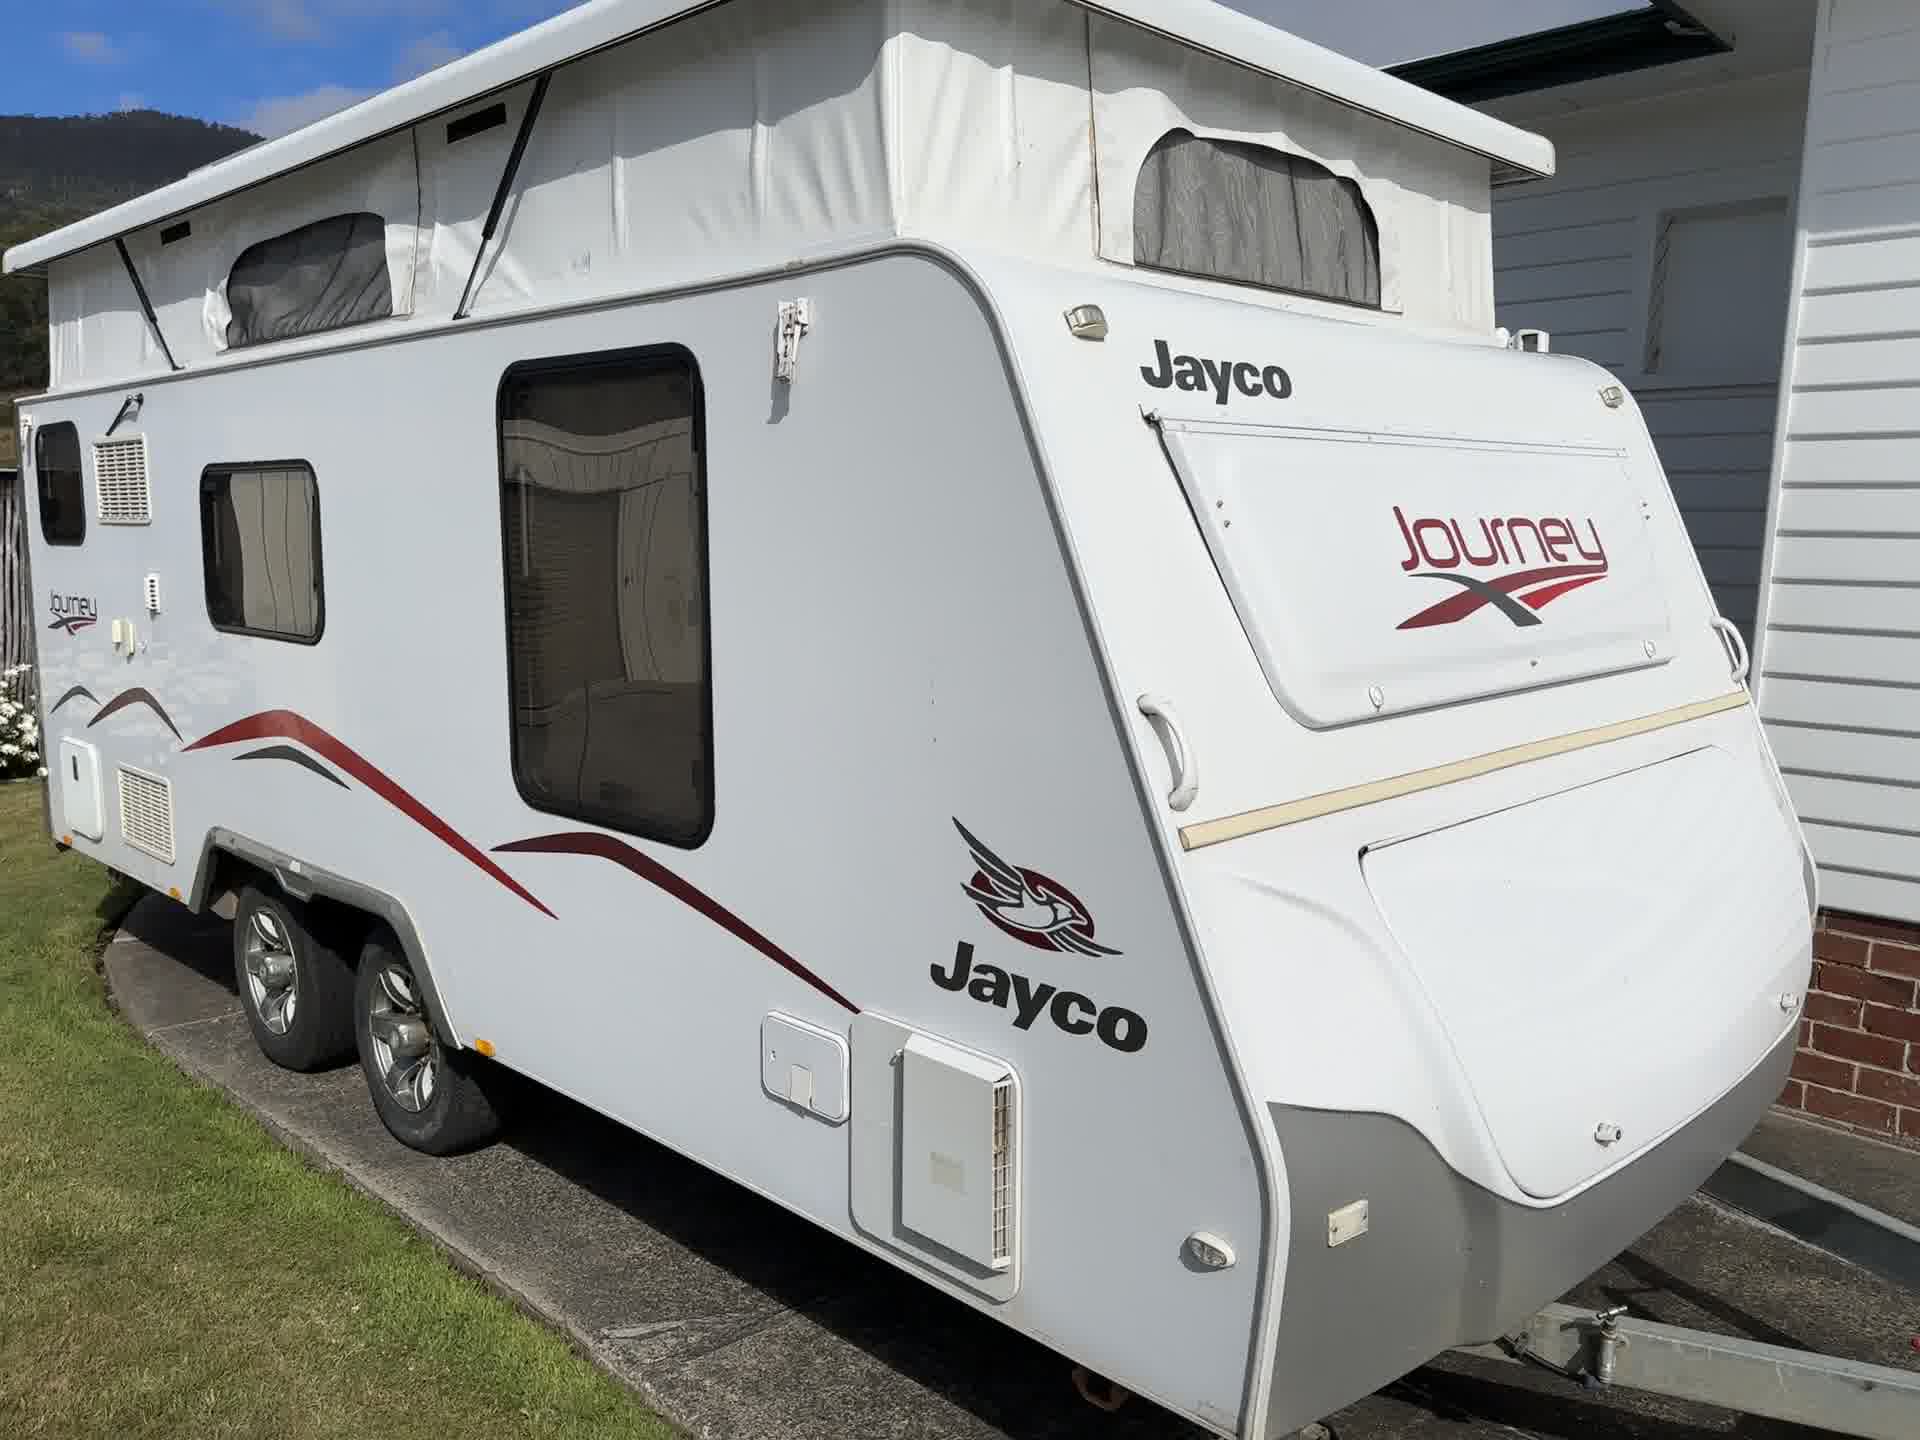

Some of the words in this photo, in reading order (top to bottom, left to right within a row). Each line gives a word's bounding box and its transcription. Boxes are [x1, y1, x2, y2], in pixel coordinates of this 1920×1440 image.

[1140, 339, 1291, 404] Jayco
[1393, 505, 1608, 571] Journey
[49, 589, 96, 618] Journey
[930, 941, 1147, 1052] Jayco
